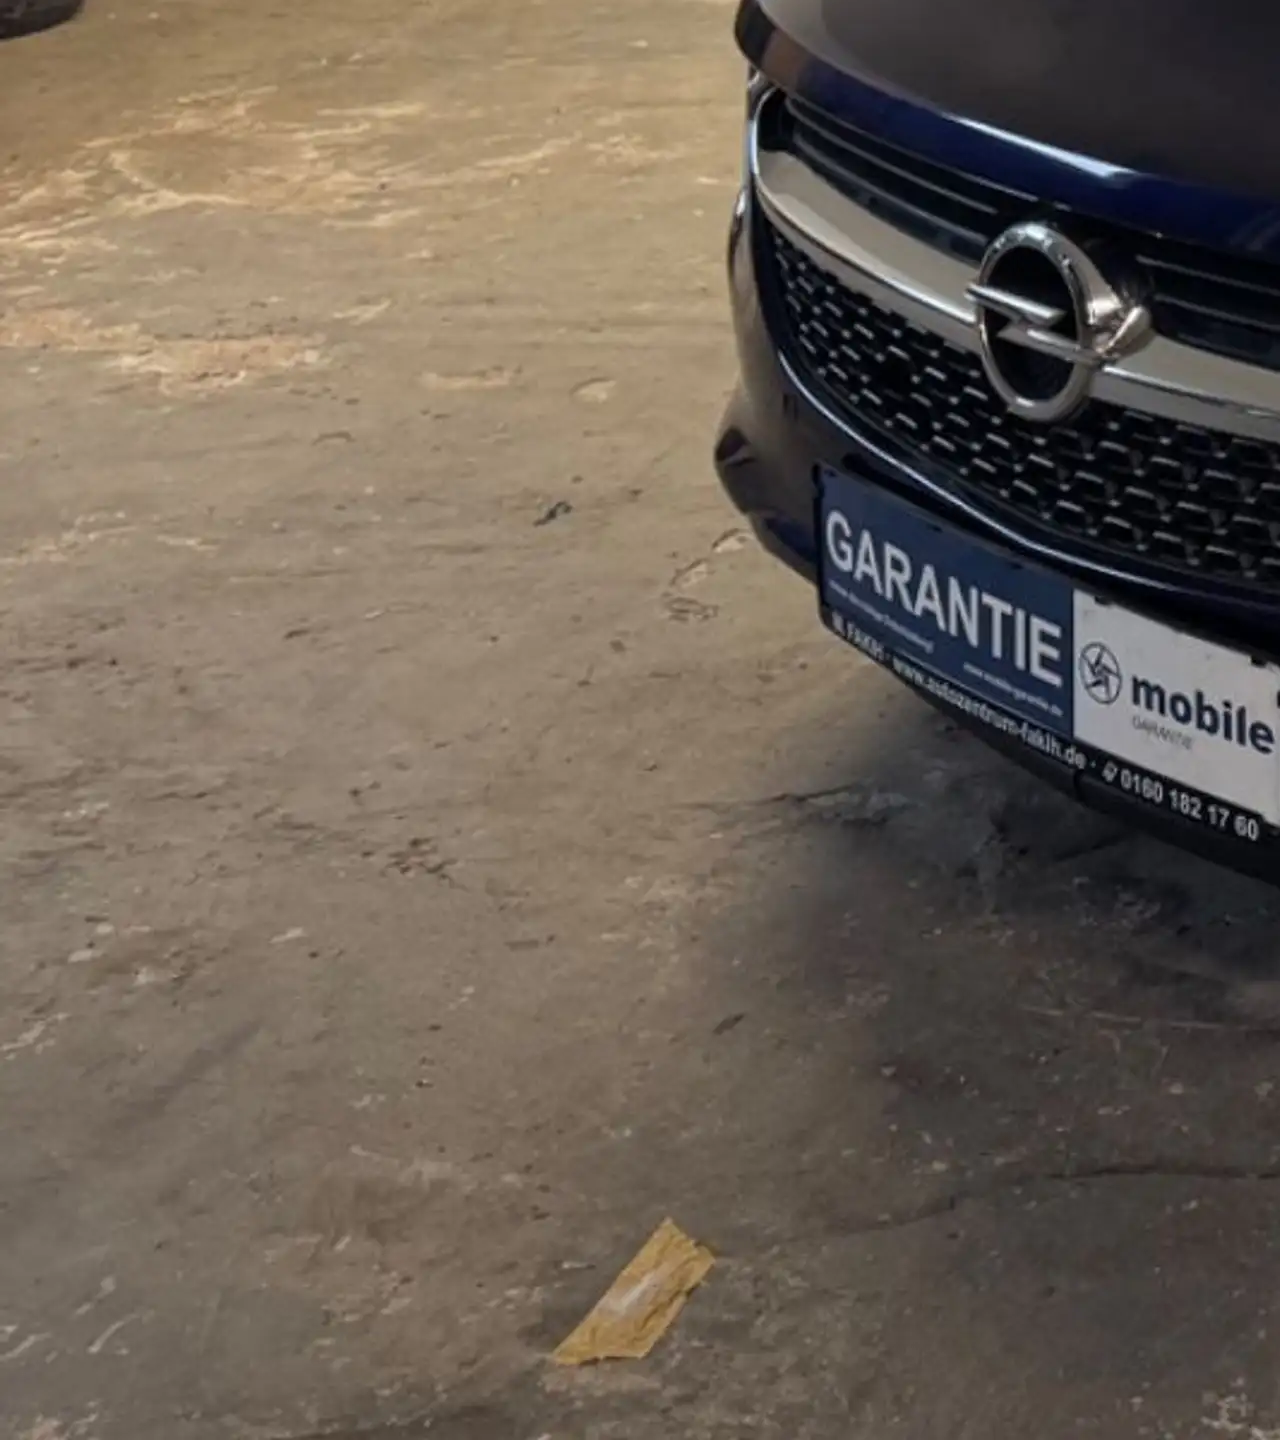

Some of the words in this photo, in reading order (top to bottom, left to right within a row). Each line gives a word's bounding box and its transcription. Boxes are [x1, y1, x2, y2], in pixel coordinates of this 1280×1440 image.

[824, 510, 1064, 689] GARANTIE
[1131, 672, 1276, 755] mobile
[1120, 768, 1163, 804] 0160
[1169, 788, 1202, 820] 182
[1207, 803, 1230, 831] 17
[1233, 814, 1260, 842] 60
